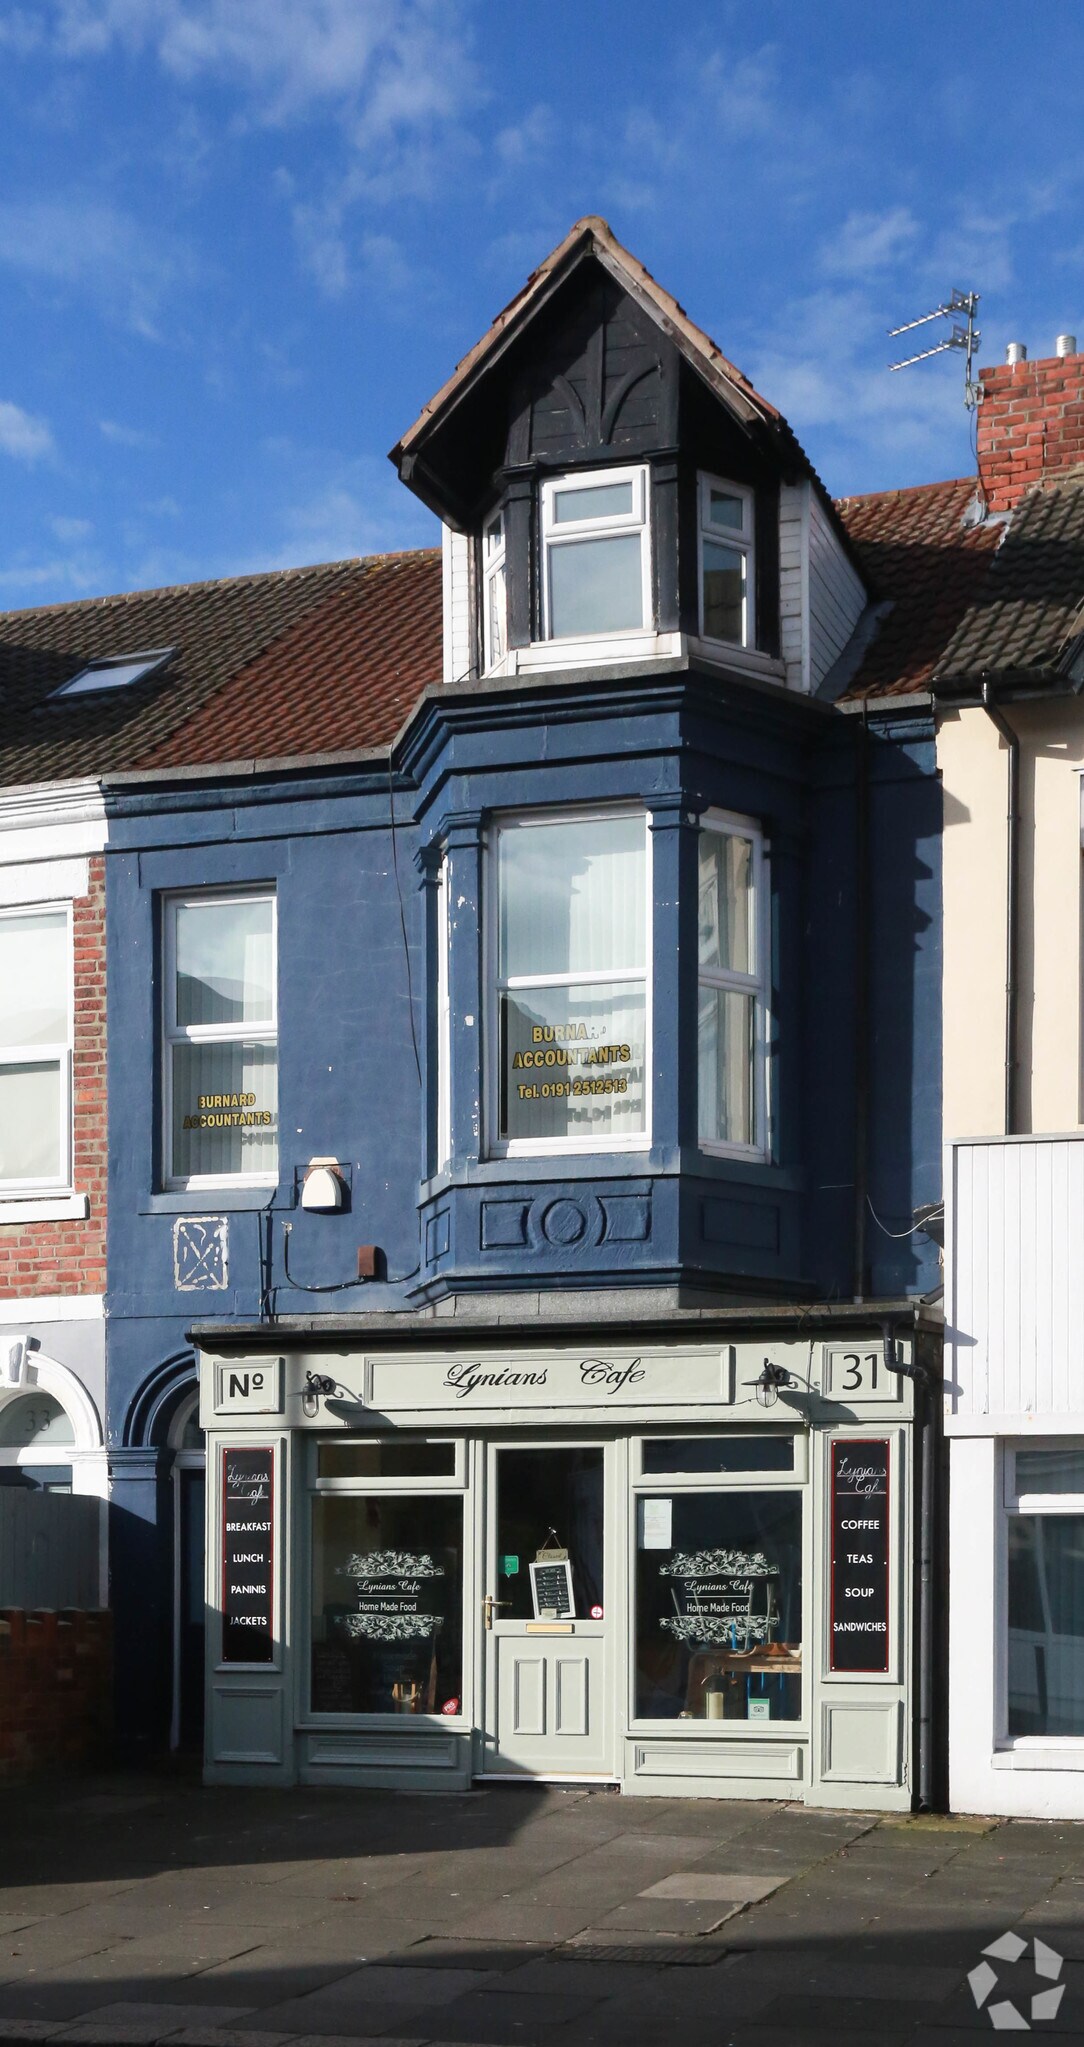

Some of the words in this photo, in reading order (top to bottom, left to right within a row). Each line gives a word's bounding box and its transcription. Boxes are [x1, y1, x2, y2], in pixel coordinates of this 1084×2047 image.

[532, 1023, 606, 1043] BURNA
[512, 1044, 631, 1069] ACCOUNTANTS
[541, 1082, 570, 1098] 0191
[572, 1079, 628, 1096] 2512513
[198, 1092, 256, 1109] BURNARD
[183, 1111, 271, 1129] ACCOUNTANTS
[443, 1363, 547, 1398] Lynians
[579, 1357, 646, 1395] Cafe
[842, 1353, 878, 1390] 31
[25, 1409, 51, 1431] 33
[227, 1464, 269, 1488] Lyans
[241, 1484, 265, 1506] af
[855, 1476, 882, 1500] Caf
[226, 1522, 272, 1532] BREAKFAST
[841, 1519, 880, 1530] COFFEE
[232, 1553, 264, 1563] LUNCH
[846, 1554, 874, 1564] TEAS
[231, 1585, 267, 1594] PANINIS
[356, 1580, 397, 1593] Lynians
[398, 1580, 421, 1593] Cafe
[684, 1580, 728, 1594] Lynians
[729, 1580, 754, 1594] Cafe
[845, 1588, 875, 1598] SOUP
[359, 1602, 379, 1611] Home
[380, 1602, 399, 1611] Made
[400, 1602, 417, 1611] Food
[686, 1603, 708, 1612] Home
[710, 1603, 730, 1612] Made
[731, 1603, 750, 1612] Food
[230, 1616, 267, 1626] JACKETS
[833, 1622, 887, 1632] SANDWICHES
